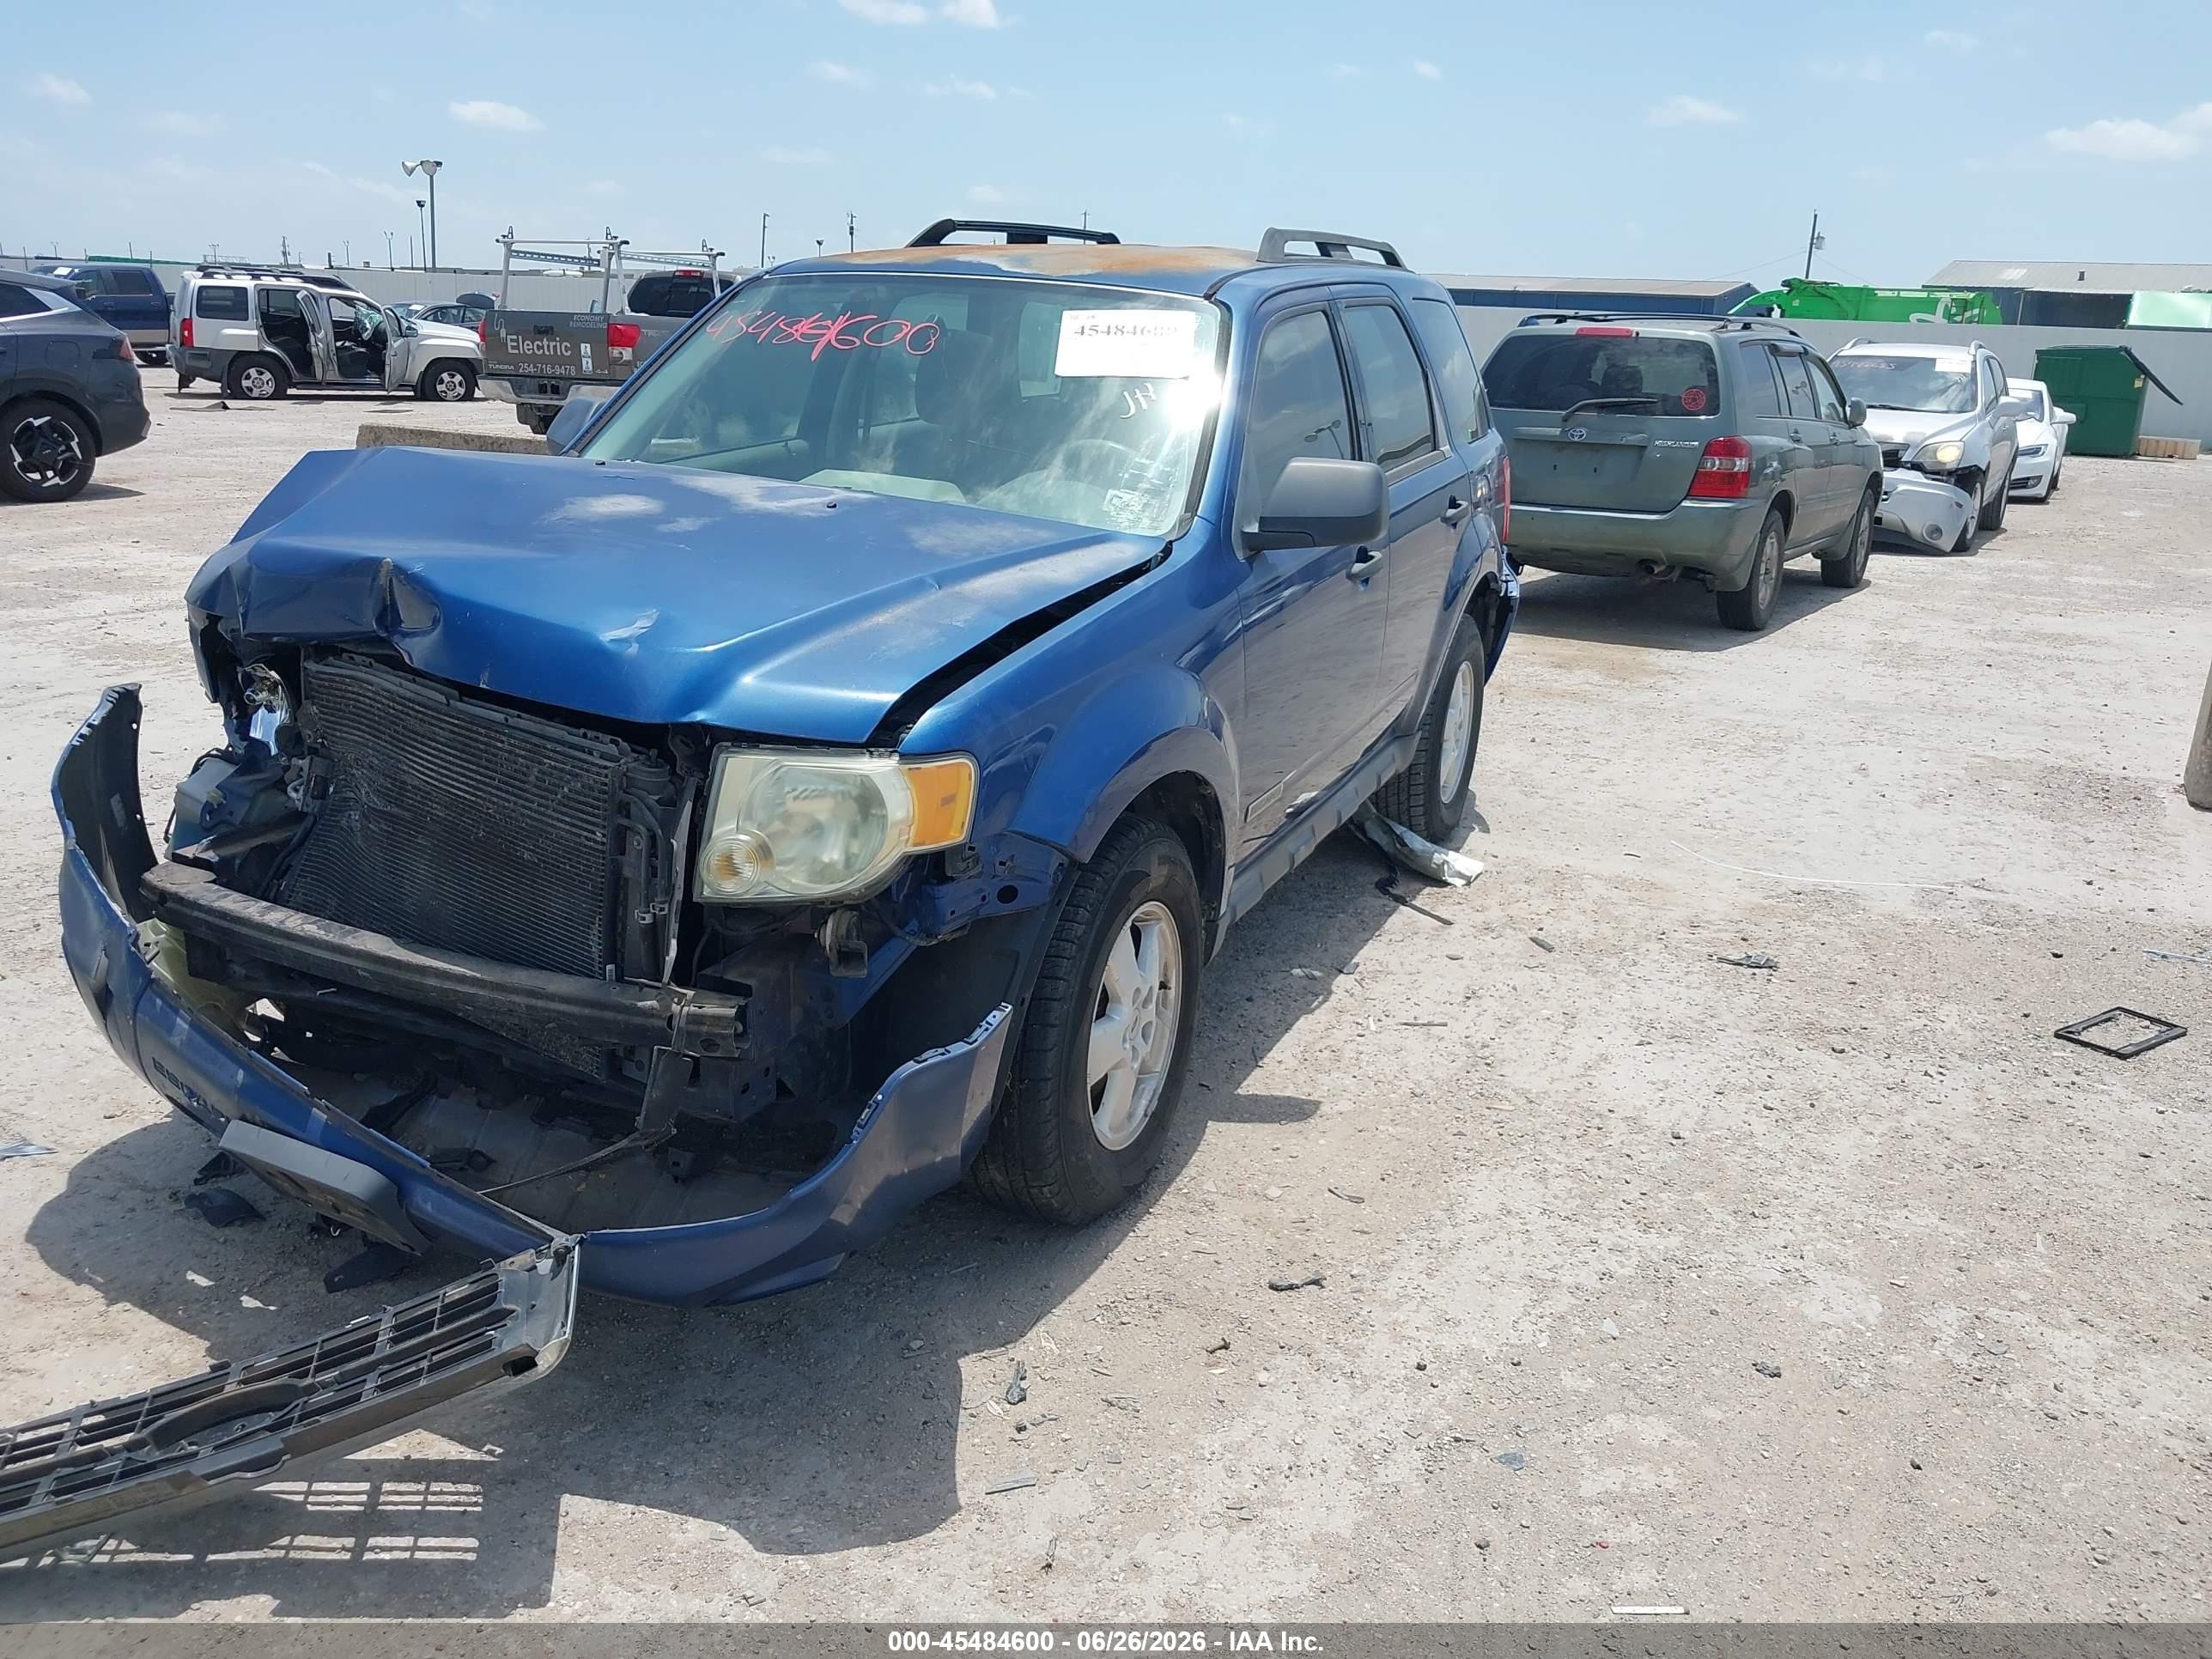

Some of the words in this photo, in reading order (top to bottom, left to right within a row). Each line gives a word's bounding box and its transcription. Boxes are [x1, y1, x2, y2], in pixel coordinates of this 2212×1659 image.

[569, 320, 607, 329] REMODELING
[507, 335, 572, 357] Electric
[519, 362, 576, 376] 254-716-9478
